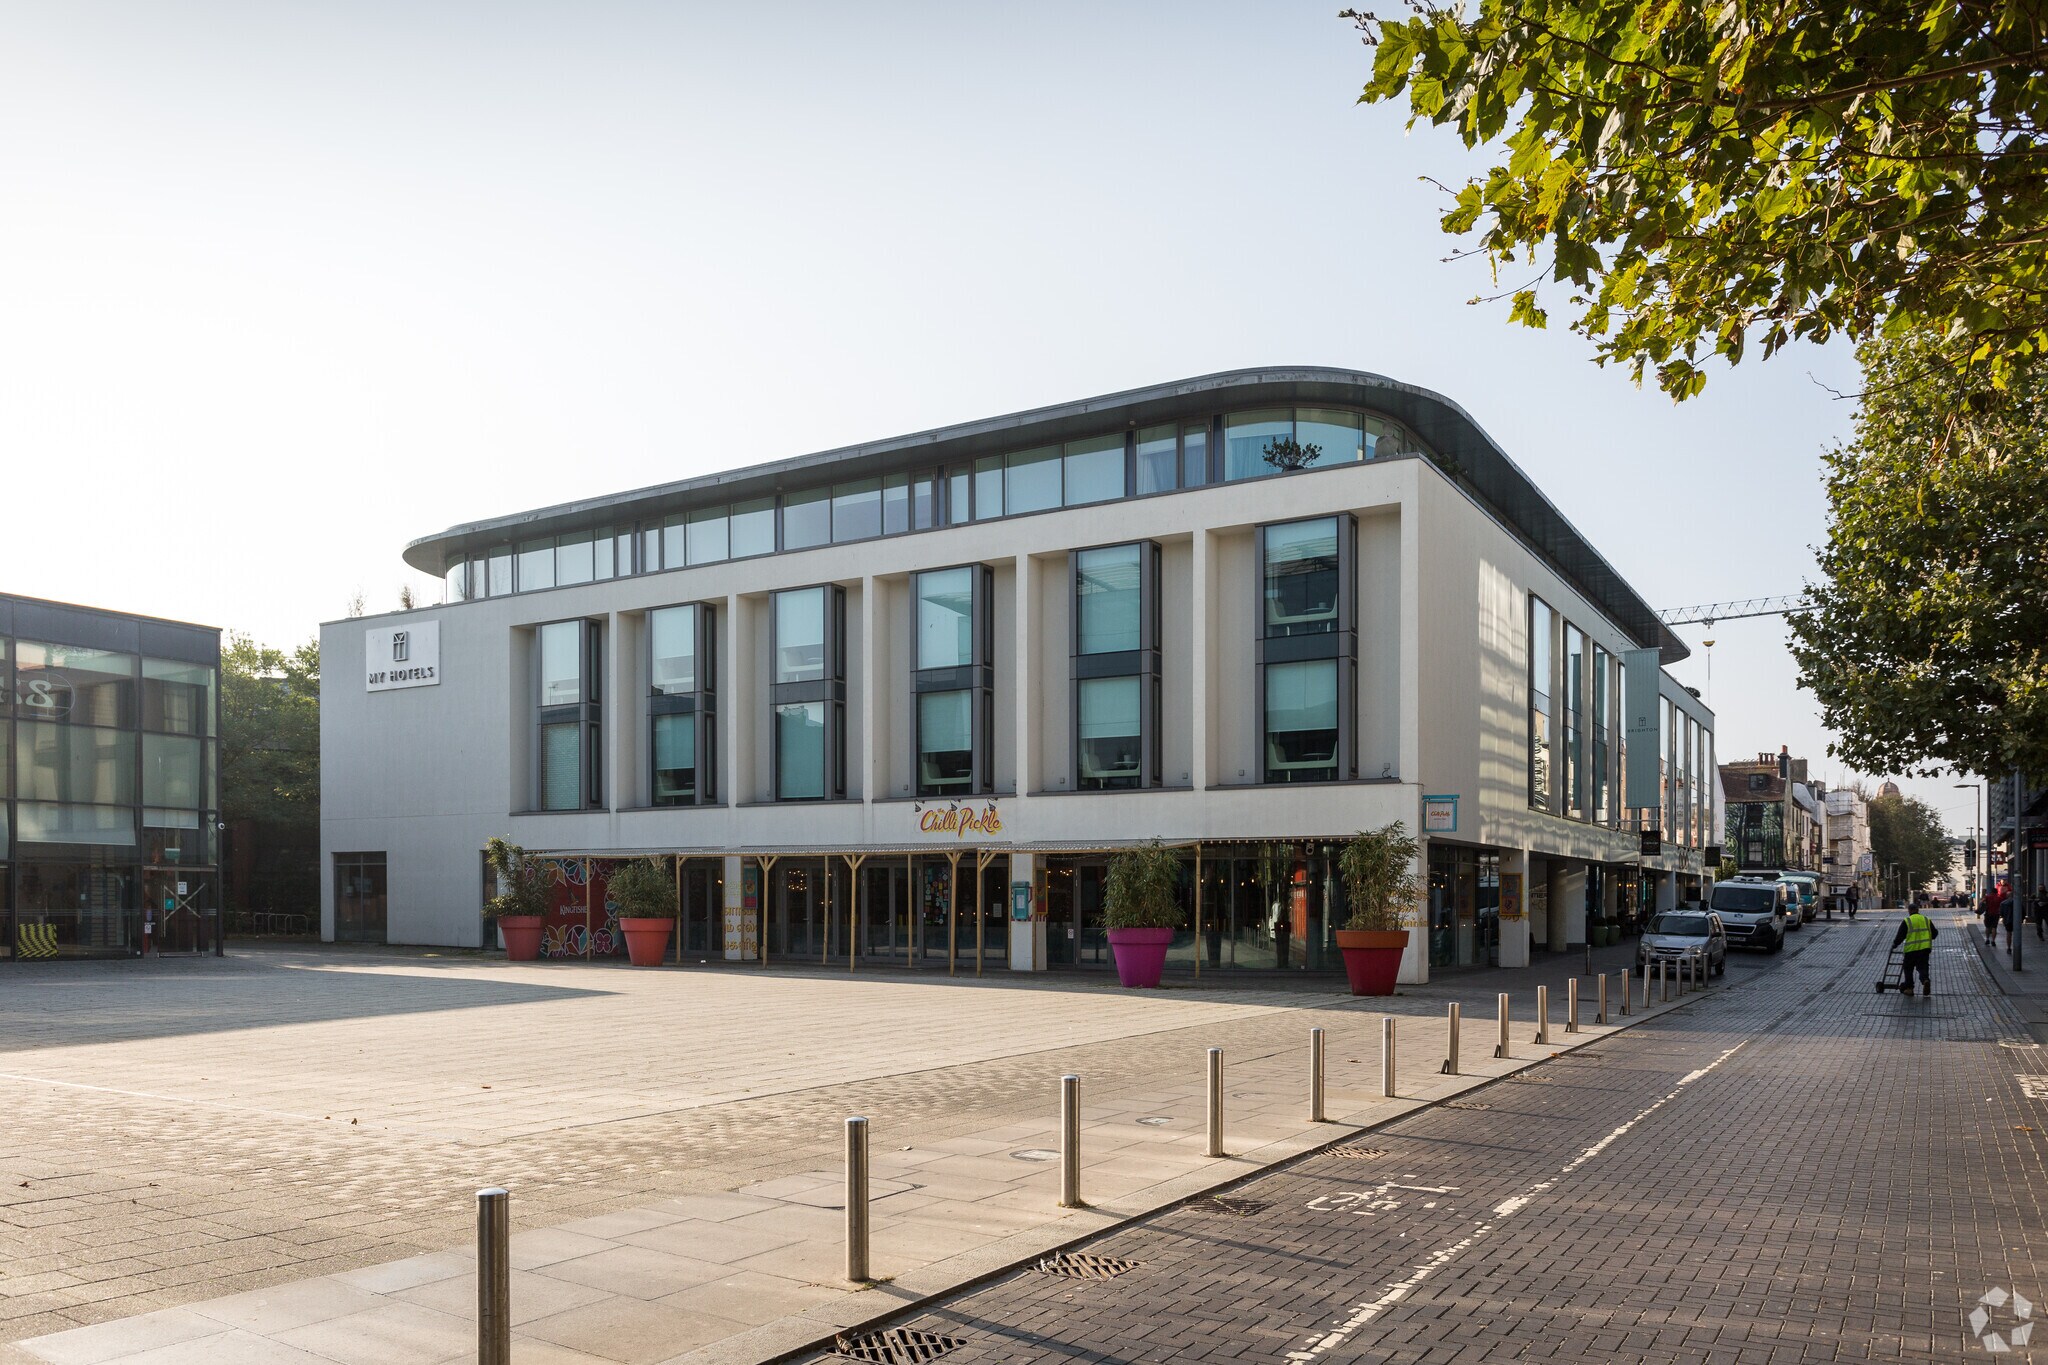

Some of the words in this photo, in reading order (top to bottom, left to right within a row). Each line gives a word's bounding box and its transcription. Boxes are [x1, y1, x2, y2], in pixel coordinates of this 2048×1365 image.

[368, 672, 386, 685] MY
[389, 666, 435, 682] HOTELS
[920, 808, 957, 833] Chilli
[957, 806, 1003, 840] Pickle
[559, 904, 588, 916] KINGFISHE
